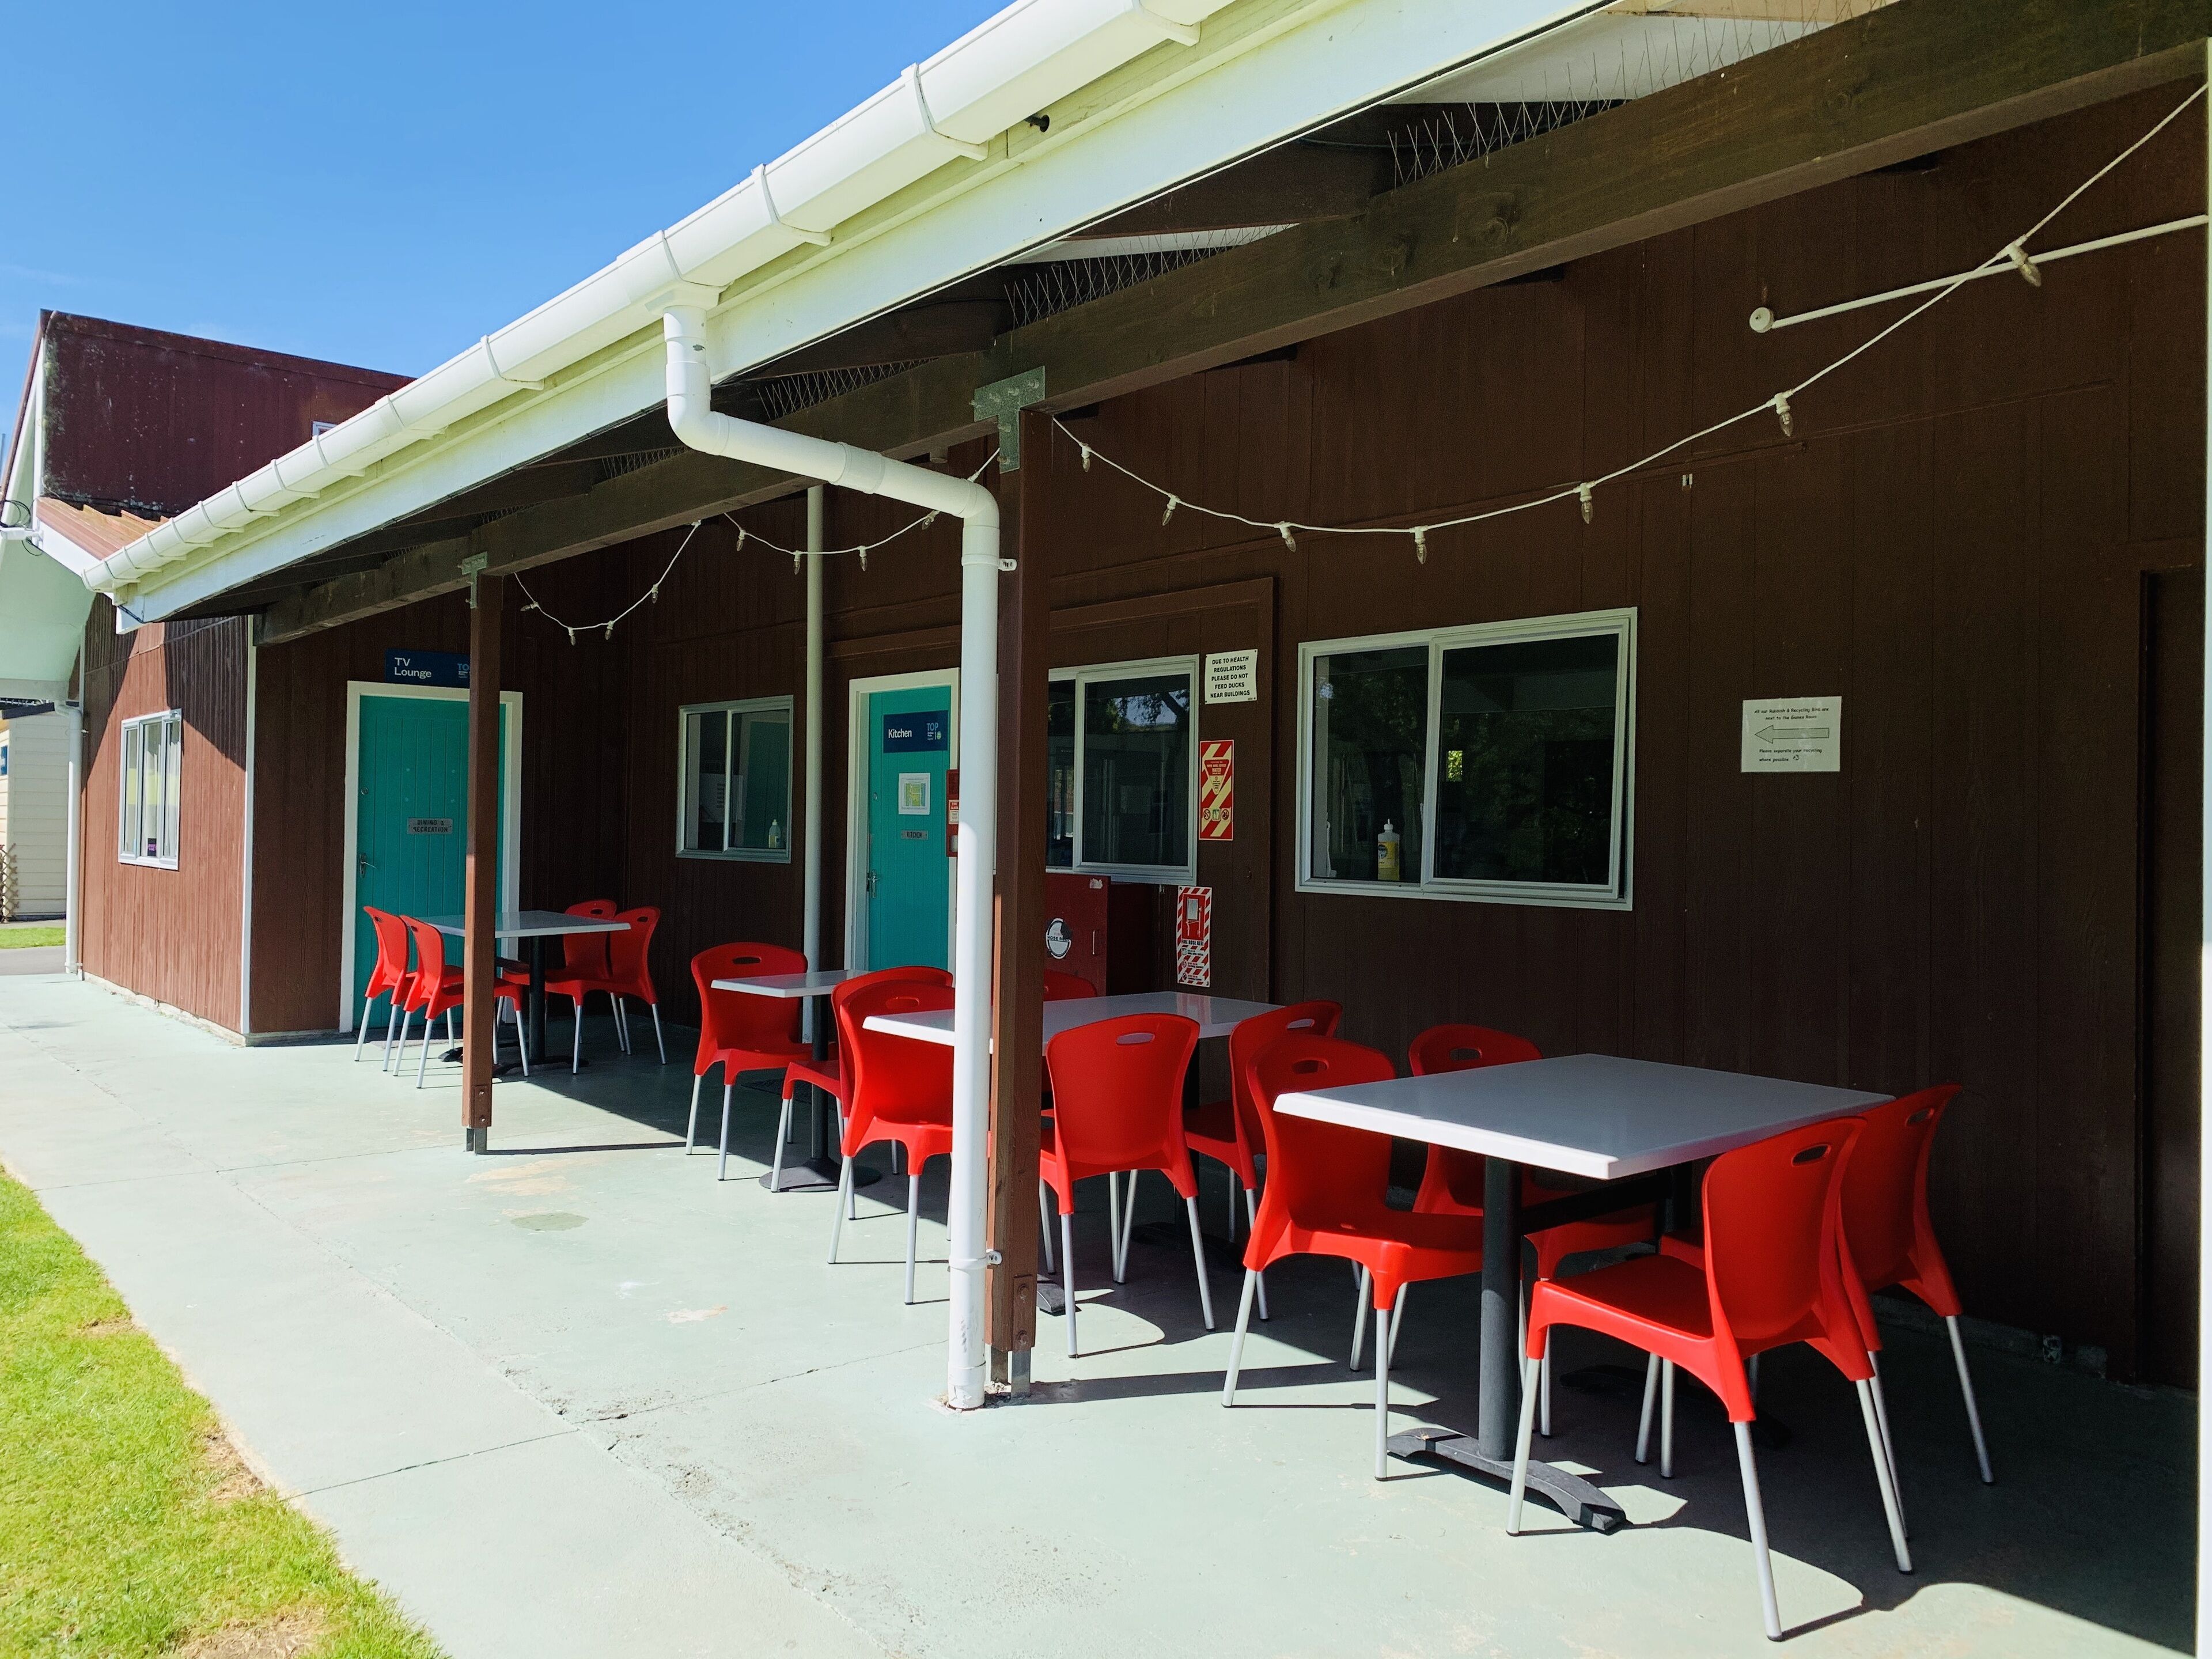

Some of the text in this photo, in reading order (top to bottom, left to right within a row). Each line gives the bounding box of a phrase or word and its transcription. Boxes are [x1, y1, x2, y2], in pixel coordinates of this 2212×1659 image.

[394, 657, 411, 666] TV
[457, 663, 470, 671] TO
[1214, 665, 1246, 673] REGULATIONS
[394, 667, 431, 679] Lounge
[926, 722, 939, 731] TOP
[888, 728, 912, 738] Kitchen
